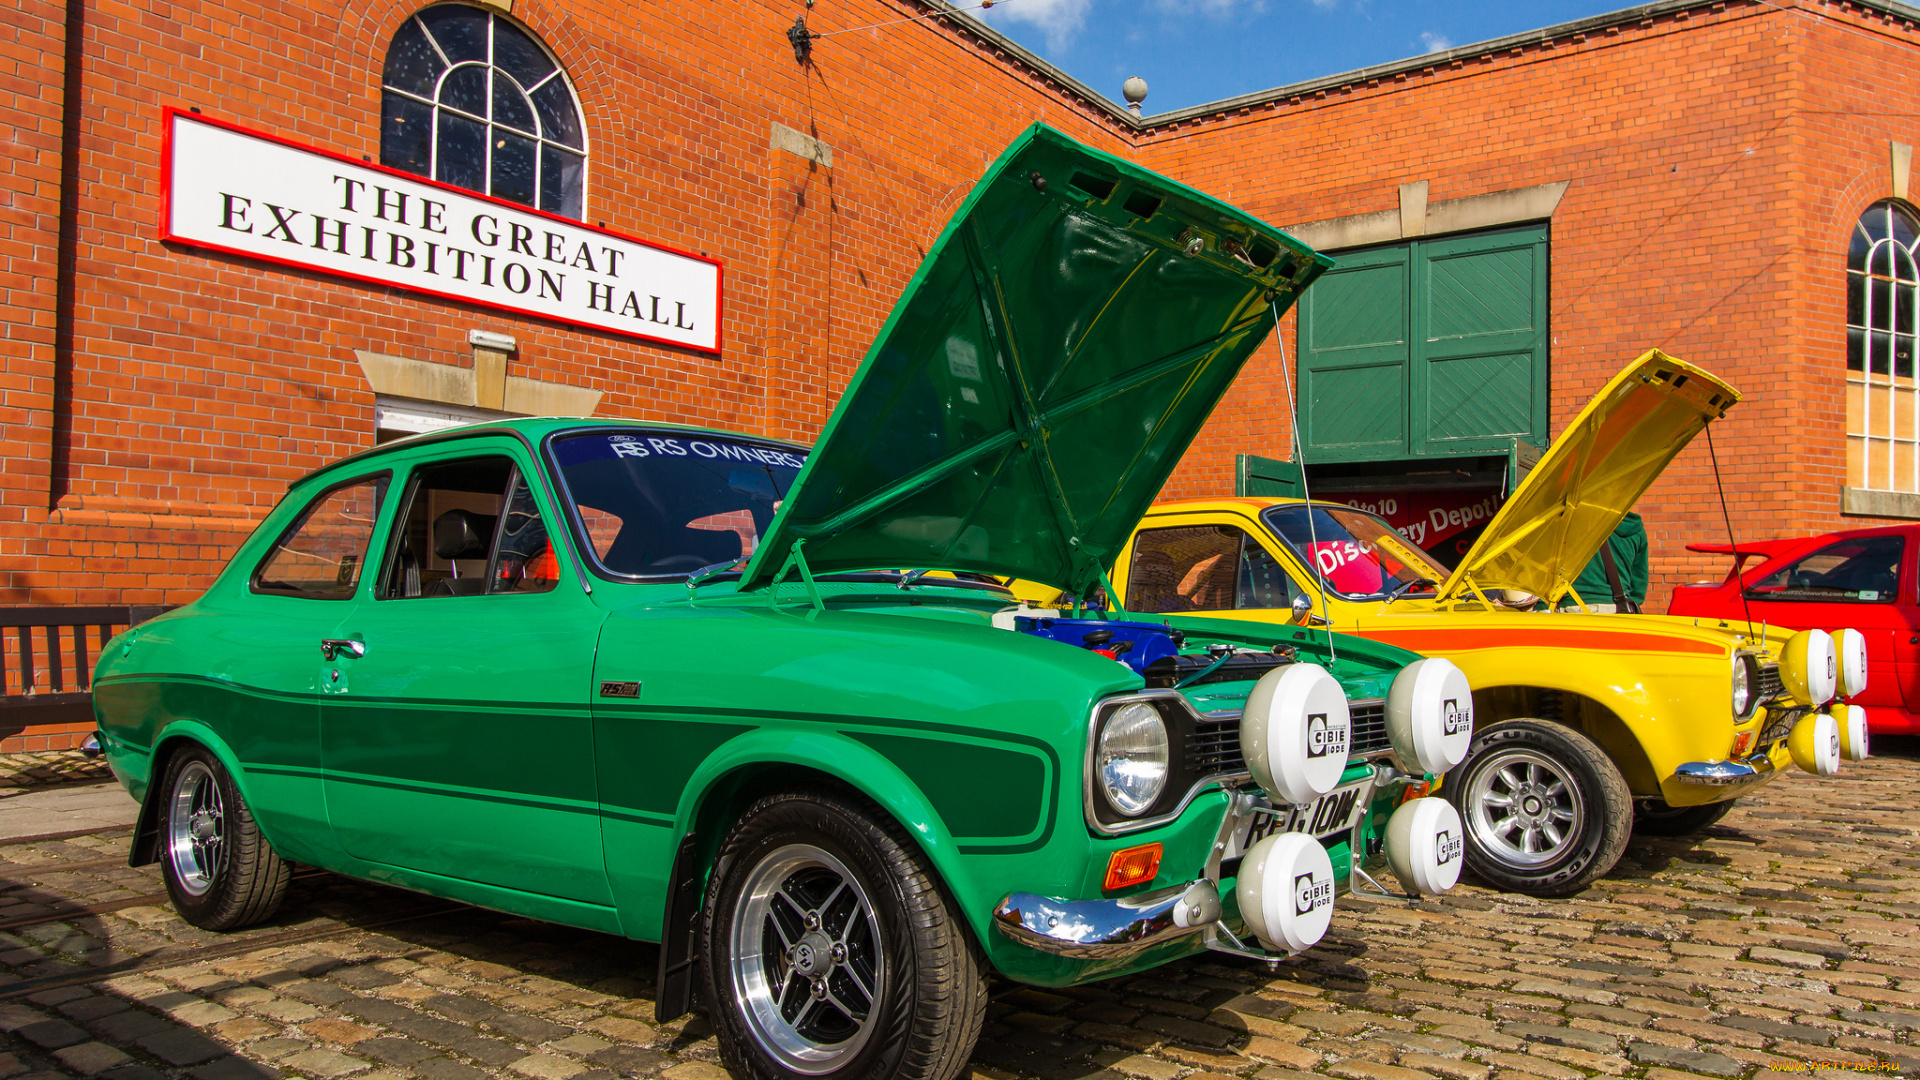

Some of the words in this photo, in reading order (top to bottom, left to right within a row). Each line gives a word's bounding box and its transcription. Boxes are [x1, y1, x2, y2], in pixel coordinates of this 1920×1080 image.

[334, 175, 448, 235] THE
[471, 214, 625, 279] GREAT
[218, 192, 567, 302] EXHIBITION
[586, 280, 694, 330] HALL
[647, 438, 688, 456] RS
[690, 441, 804, 469] OWNERS
[1378, 499, 1397, 515] 10
[1428, 494, 1499, 533] Depot!
[1448, 712, 1469, 724] CIBIE
[1314, 730, 1345, 744] CIBIE
[1327, 744, 1345, 754] IODE
[1441, 839, 1461, 854] CIBIE
[1302, 883, 1330, 901] CIBIE
[1314, 896, 1331, 908] IODE
